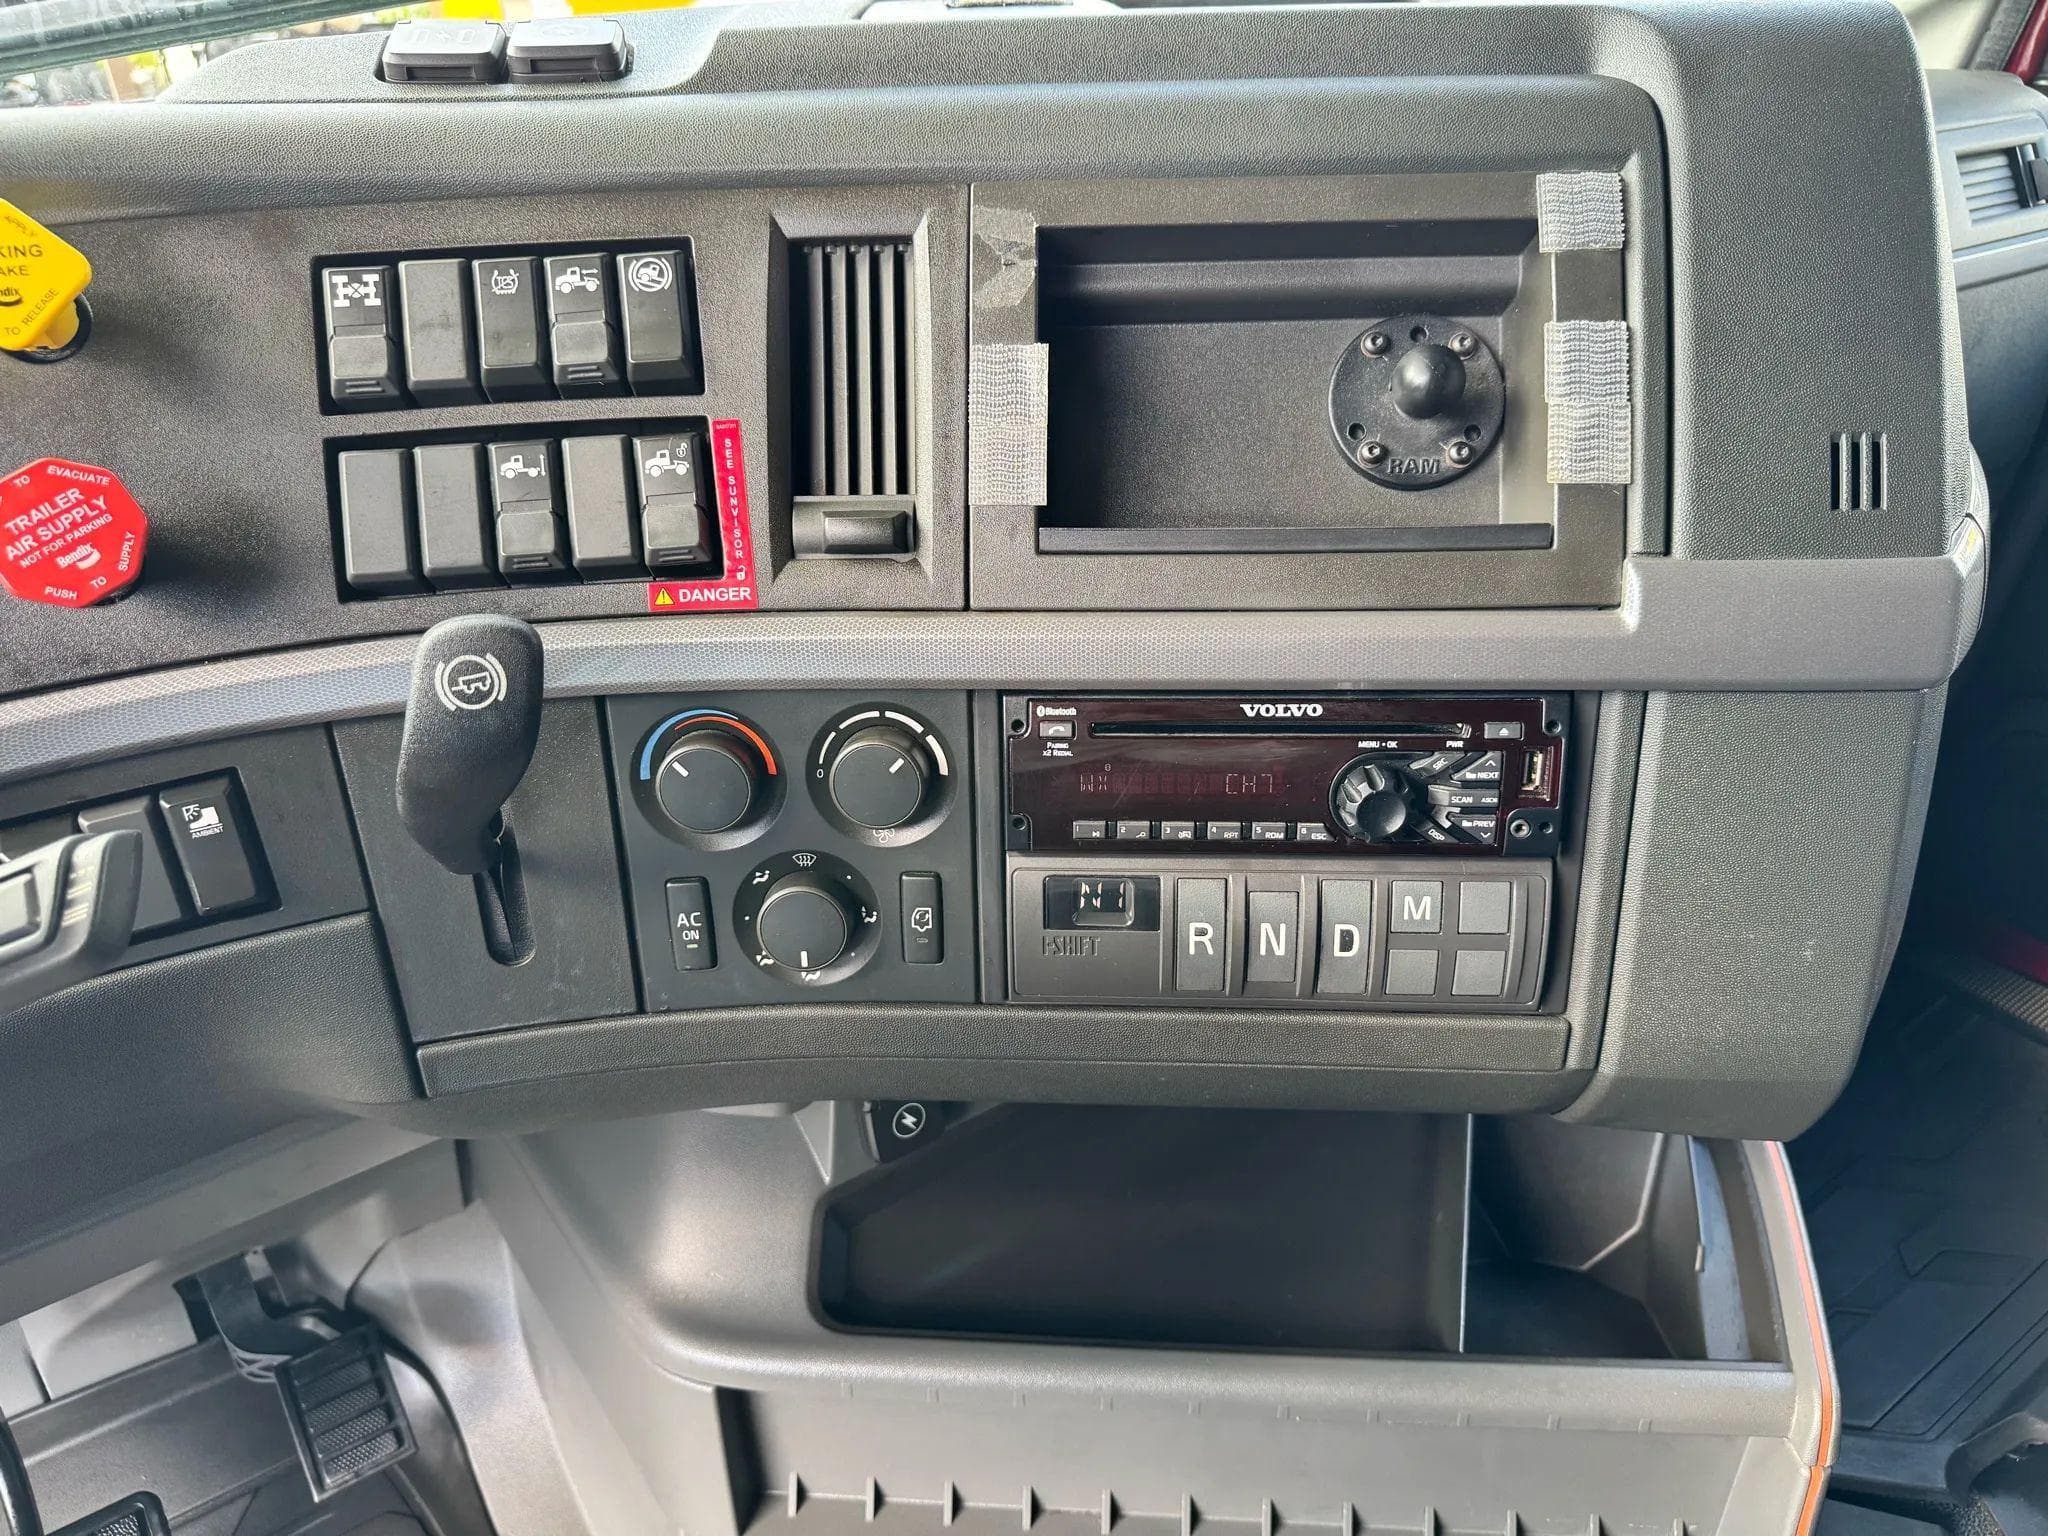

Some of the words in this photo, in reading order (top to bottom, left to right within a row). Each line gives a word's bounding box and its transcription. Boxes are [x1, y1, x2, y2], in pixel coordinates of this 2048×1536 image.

[21, 287, 59, 327] RELEASE
[13, 475, 31, 488] TO
[47, 464, 111, 486] EVACUATE
[1387, 457, 1440, 474] RAM
[4, 487, 85, 535] TRAILER
[727, 475, 744, 559] SUNVISOR
[5, 534, 39, 562] AIR
[36, 494, 108, 541] SUPPLY
[20, 550, 43, 568] NOT
[42, 537, 67, 555] FOR
[66, 513, 113, 543] PARKING
[44, 585, 78, 600] PUSH
[89, 575, 107, 589] TO
[117, 530, 136, 572] SUPPLY
[56, 542, 95, 568] Bendix
[679, 587, 752, 602] DANGER
[1239, 703, 1324, 717] VOLVO
[1432, 757, 1448, 771] SRC
[191, 826, 224, 839] AMBIENT
[1311, 832, 1327, 840] ESC
[1473, 820, 1496, 828] PREV
[677, 912, 702, 927] AC
[1403, 895, 1431, 920] M
[682, 930, 699, 940] ON
[1042, 935, 1101, 956] I-SHIFT
[1188, 922, 1214, 956] R
[1259, 922, 1286, 957] N
[1333, 923, 1360, 958] D
